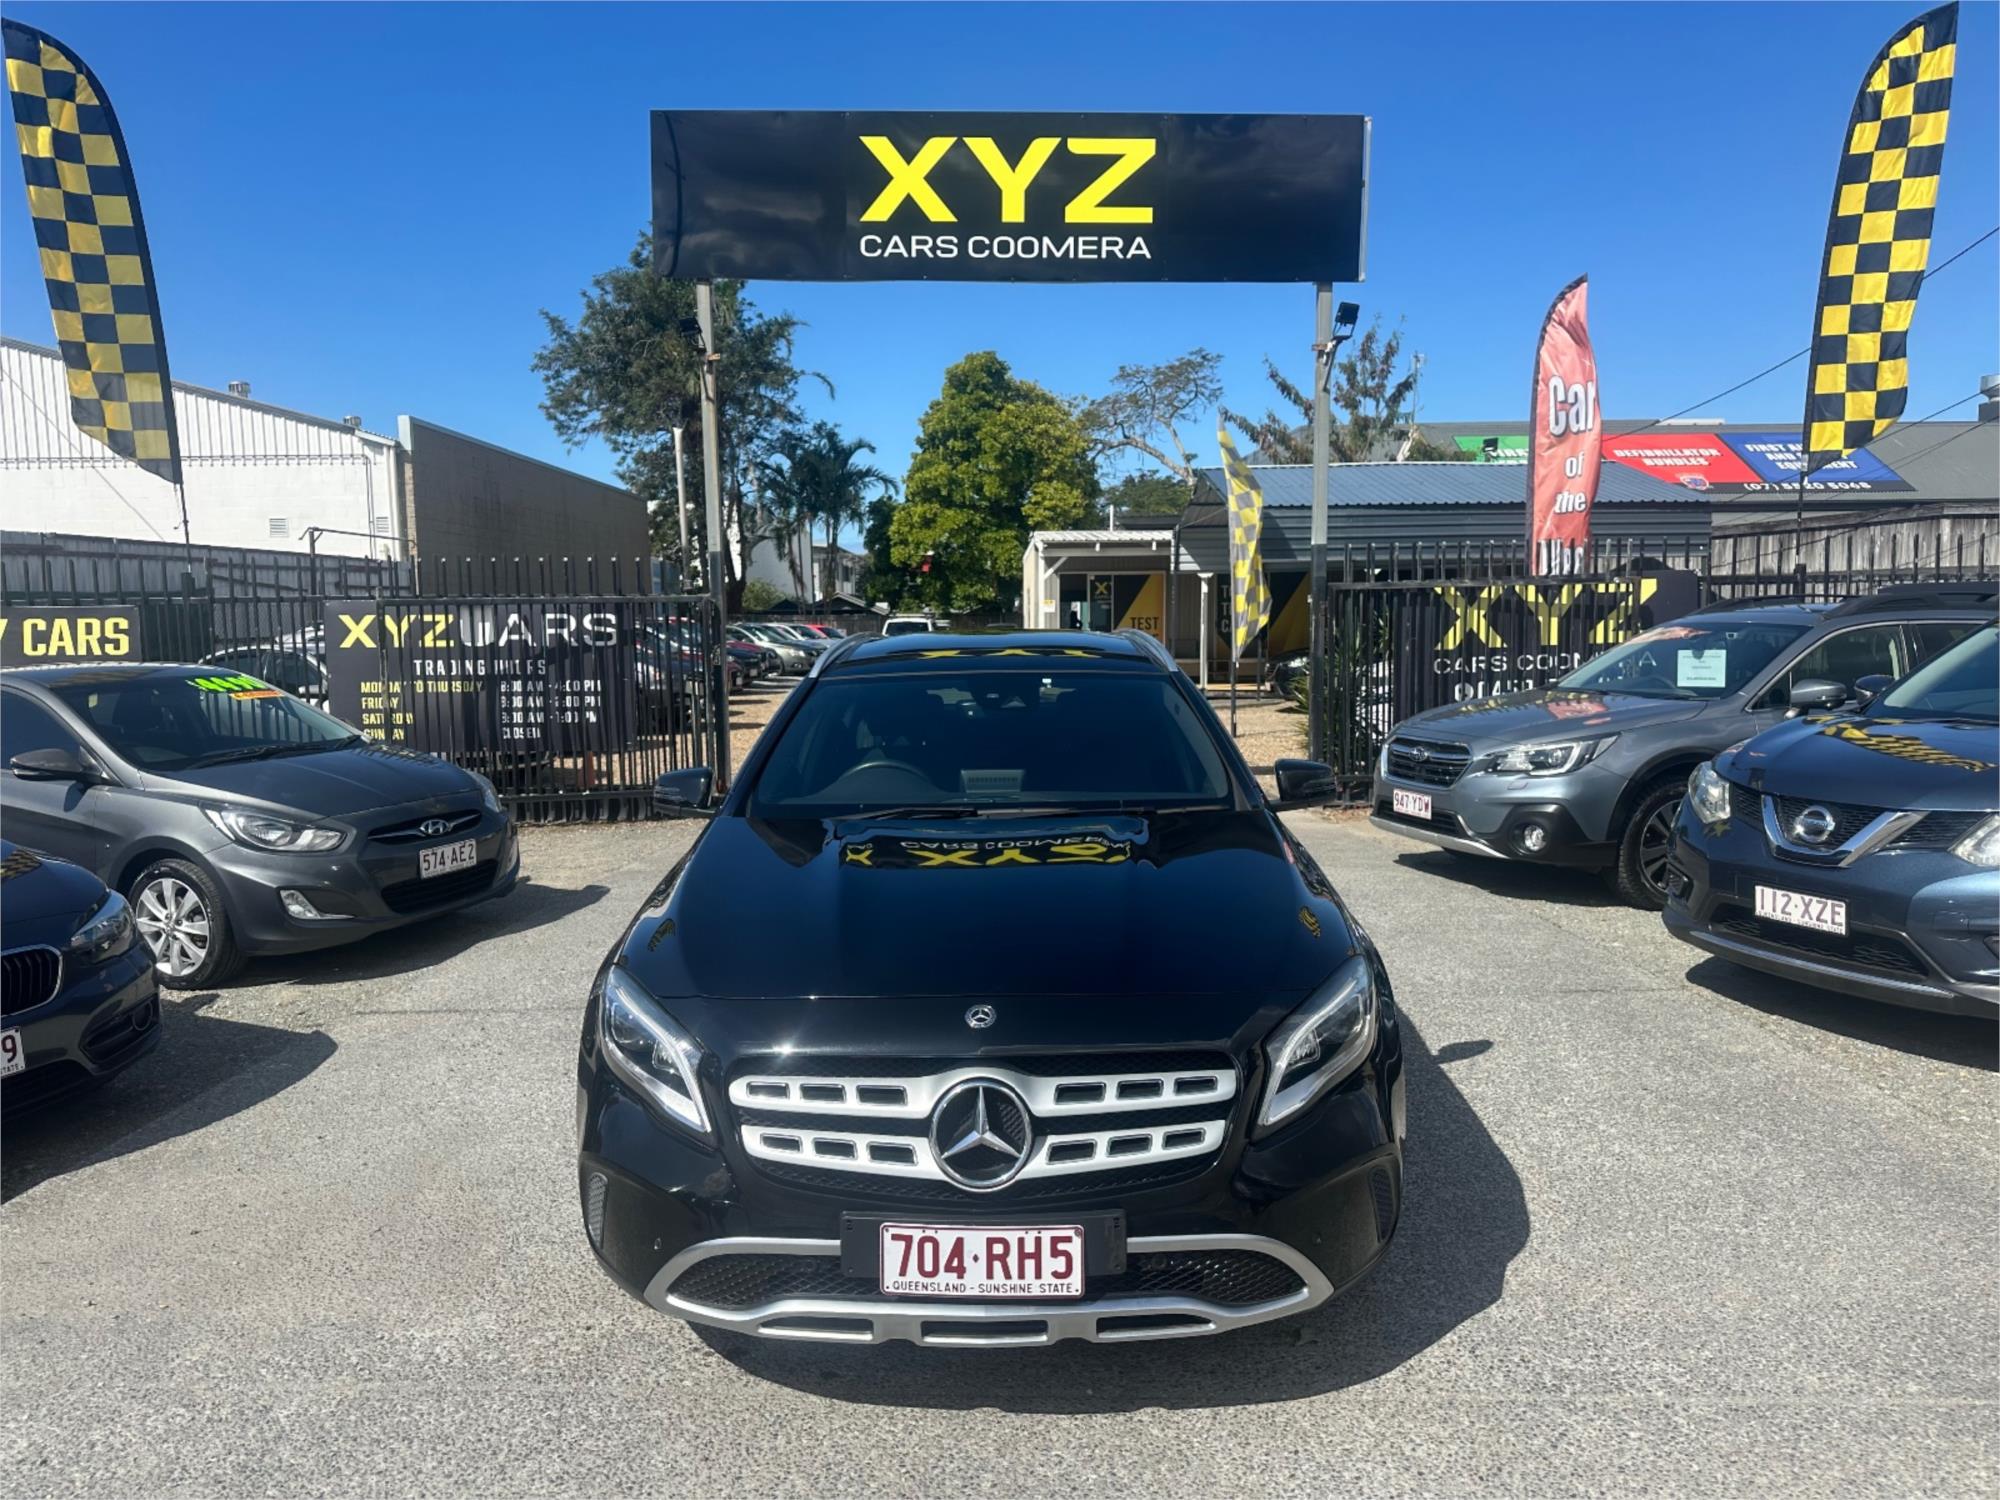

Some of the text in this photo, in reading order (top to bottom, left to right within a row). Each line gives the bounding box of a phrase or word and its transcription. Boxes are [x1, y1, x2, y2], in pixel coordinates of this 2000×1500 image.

[859, 135, 1157, 224] XYZ
[859, 234, 1152, 260] CARS COOMERA
[1548, 375, 1596, 437] Car
[1613, 447, 1722, 457] DEFIBRILLATOR
[1744, 443, 1786, 452] FIRST
[1764, 452, 1794, 461] AND
[1565, 451, 1585, 477] of
[1641, 457, 1710, 466] BUNDLES
[1553, 490, 1587, 513] the
[1130, 616, 1159, 630] TEST
[1433, 577, 1658, 650] XYZ
[23, 616, 130, 656] CARS
[337, 613, 455, 649] XYZ
[1433, 654, 1508, 675] CARS
[892, 1280, 967, 1294] QUEENSLAND
[978, 1282, 1033, 1294] SUNSHINE
[1039, 1283, 1073, 1294] STATE
